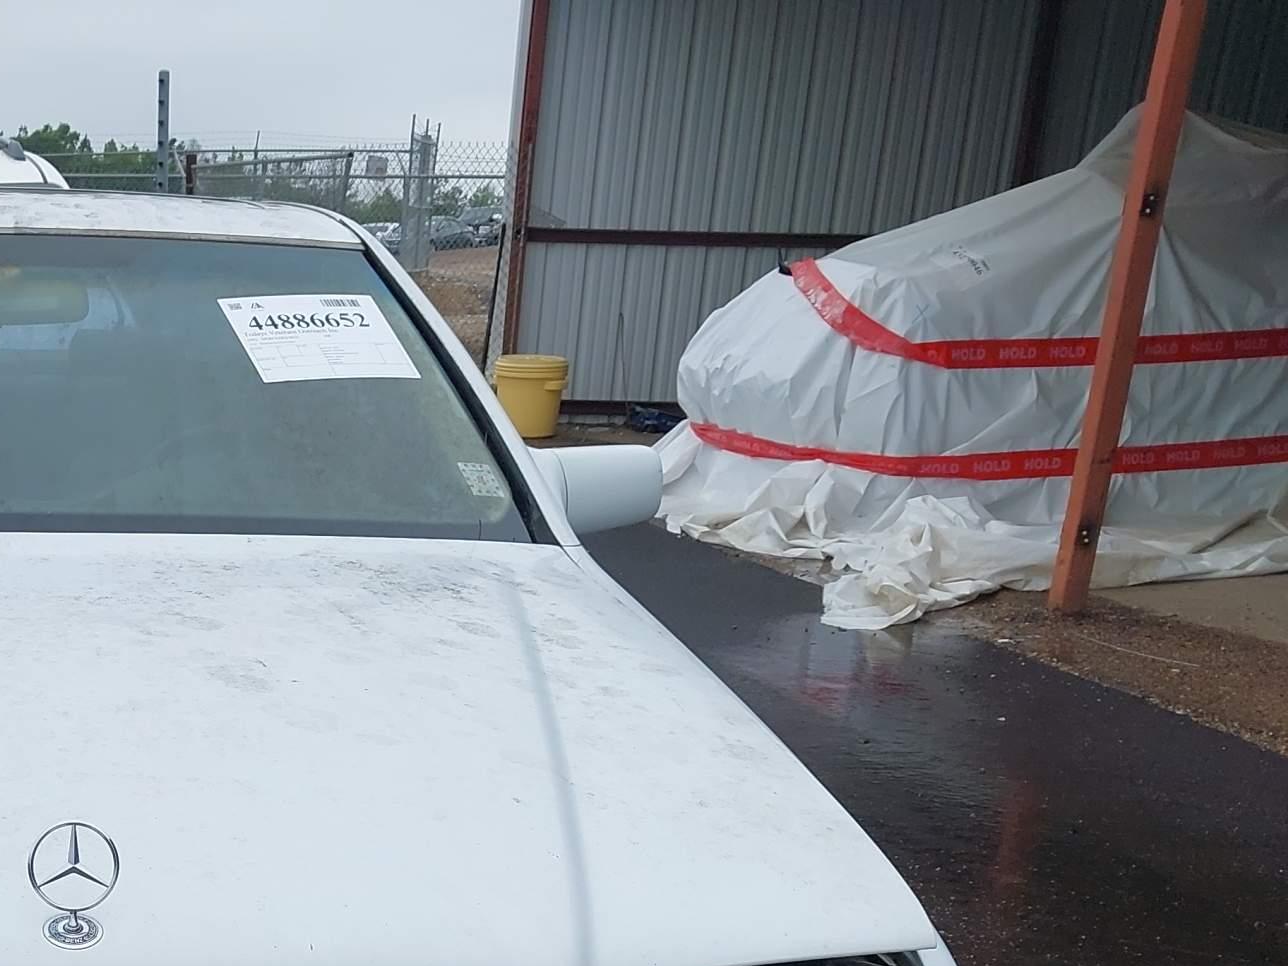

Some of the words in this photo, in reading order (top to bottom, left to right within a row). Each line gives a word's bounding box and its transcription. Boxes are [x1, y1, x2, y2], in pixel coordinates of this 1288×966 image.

[248, 312, 371, 330] 44886652
[951, 347, 985, 361] HOLD
[999, 346, 1037, 360] HOLD
[1049, 345, 1086, 359] HOLD
[1144, 342, 1179, 355] HOLD
[1191, 339, 1224, 353] HOLD
[920, 463, 960, 474] HOLD
[973, 459, 1011, 473] HOLD
[1024, 457, 1061, 470] HOLD
[1122, 453, 1154, 465] HOLD
[1165, 450, 1200, 462] HOLD
[1213, 446, 1246, 459] HOLD
